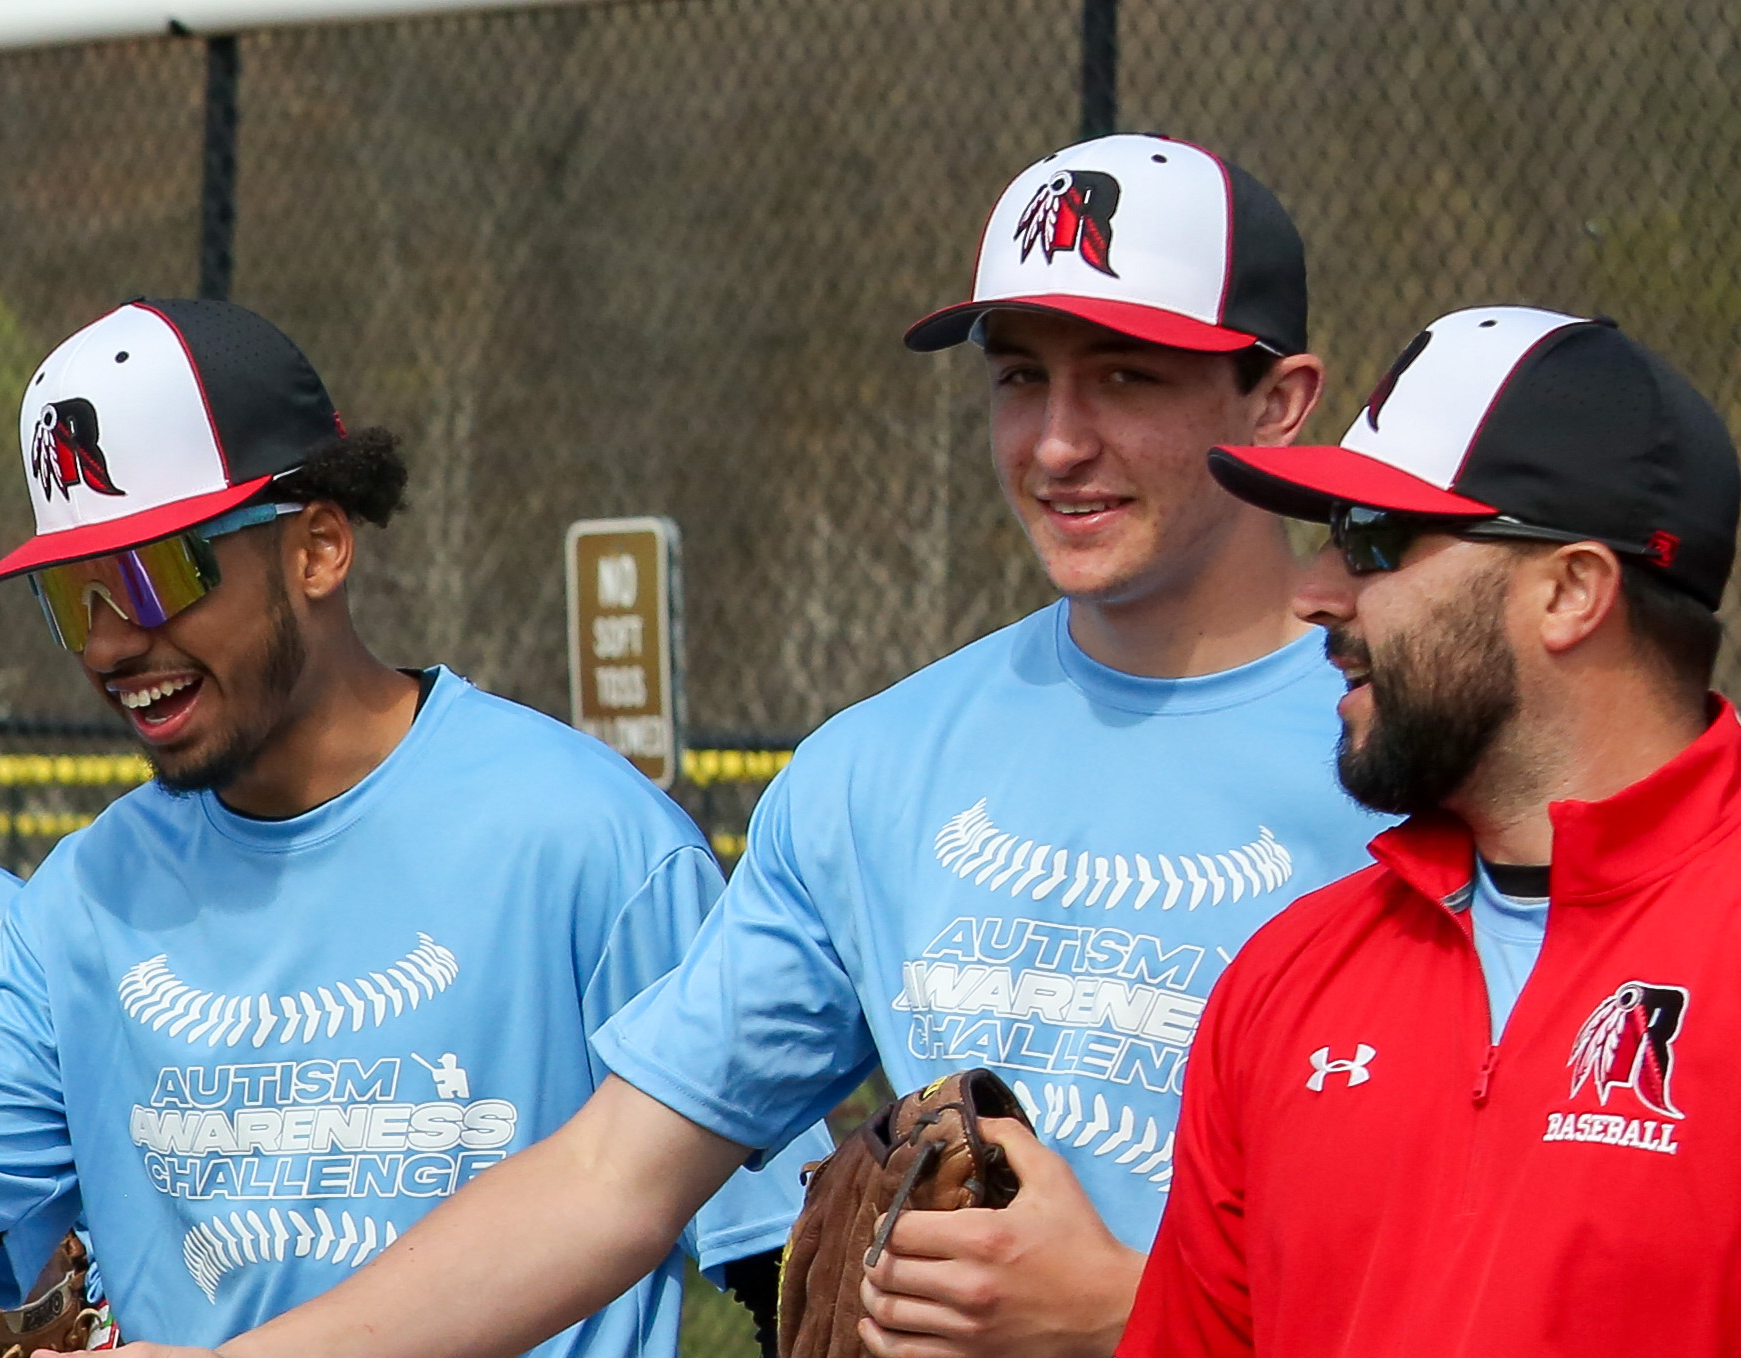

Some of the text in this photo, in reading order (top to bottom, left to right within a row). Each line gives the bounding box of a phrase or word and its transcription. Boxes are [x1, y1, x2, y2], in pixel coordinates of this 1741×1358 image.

[597, 554, 638, 609] NO
[922, 916, 1205, 990] AUTISM
[891, 960, 1207, 1047] AWARENE
[150, 1057, 402, 1108] AUTISM
[907, 1014, 1189, 1097] CHALLEN
[129, 1099, 518, 1156] AWARENESS
[1543, 1112, 1679, 1154] BASEBALL
